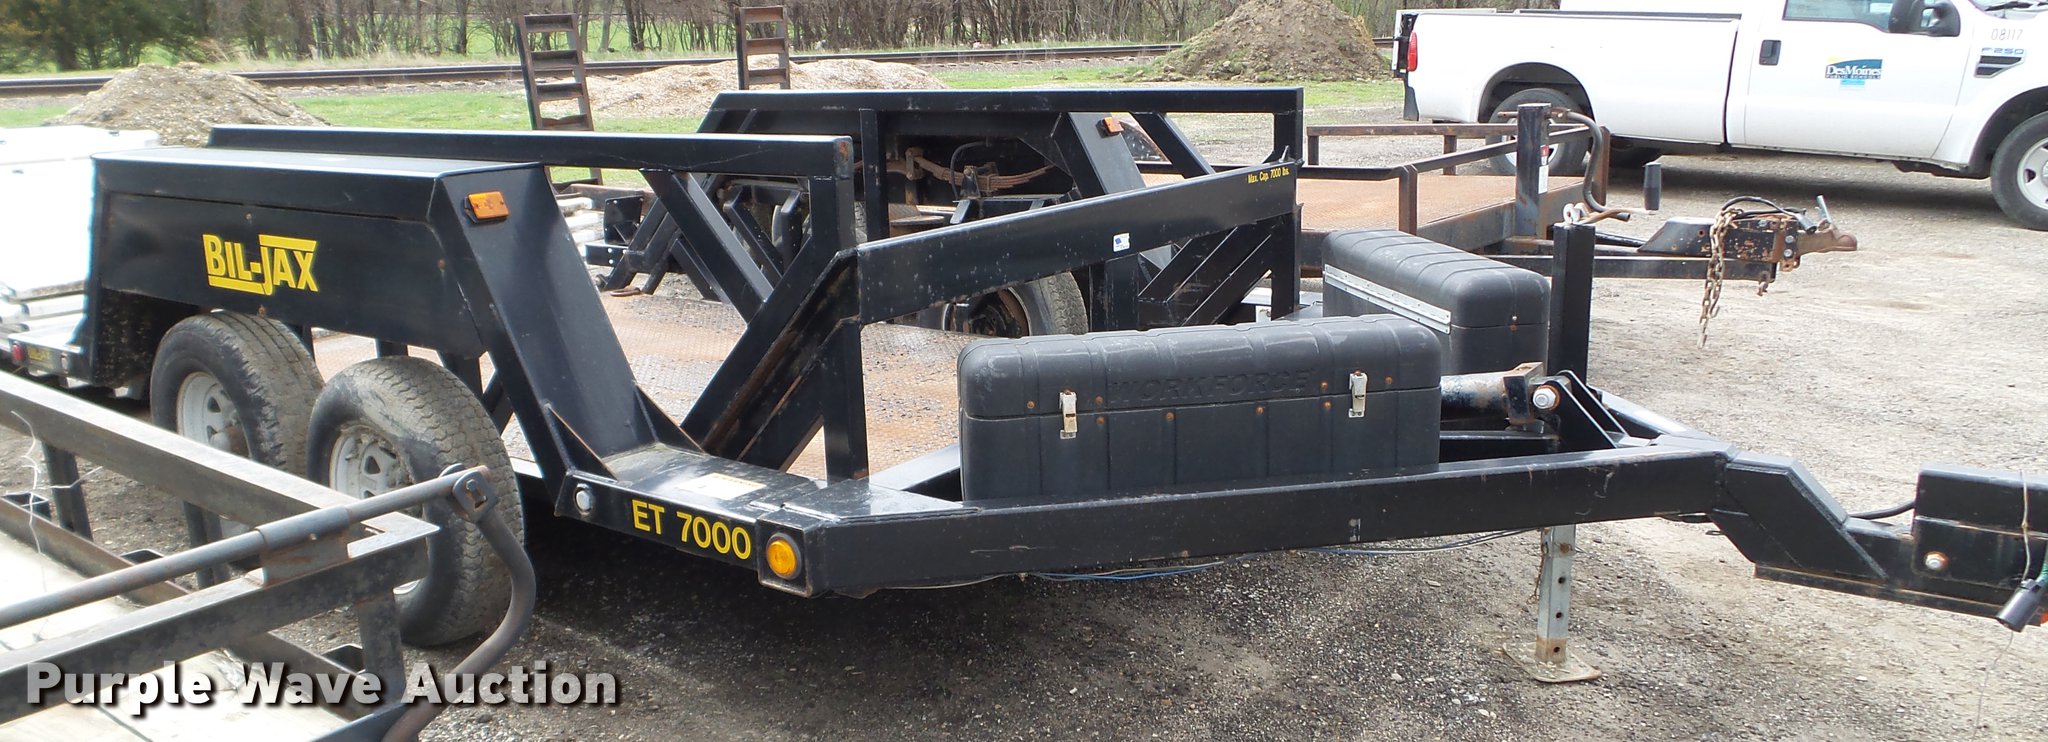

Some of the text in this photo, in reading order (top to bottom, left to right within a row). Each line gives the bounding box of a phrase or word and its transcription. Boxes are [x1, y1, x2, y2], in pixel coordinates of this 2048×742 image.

[1991, 28, 2023, 41] 08117
[1247, 173, 1258, 184] Max.
[1260, 171, 1269, 182] Cap.
[1270, 167, 1281, 179] 7000
[202, 233, 319, 296] BIL-JAX
[631, 499, 751, 560] ET 7000
